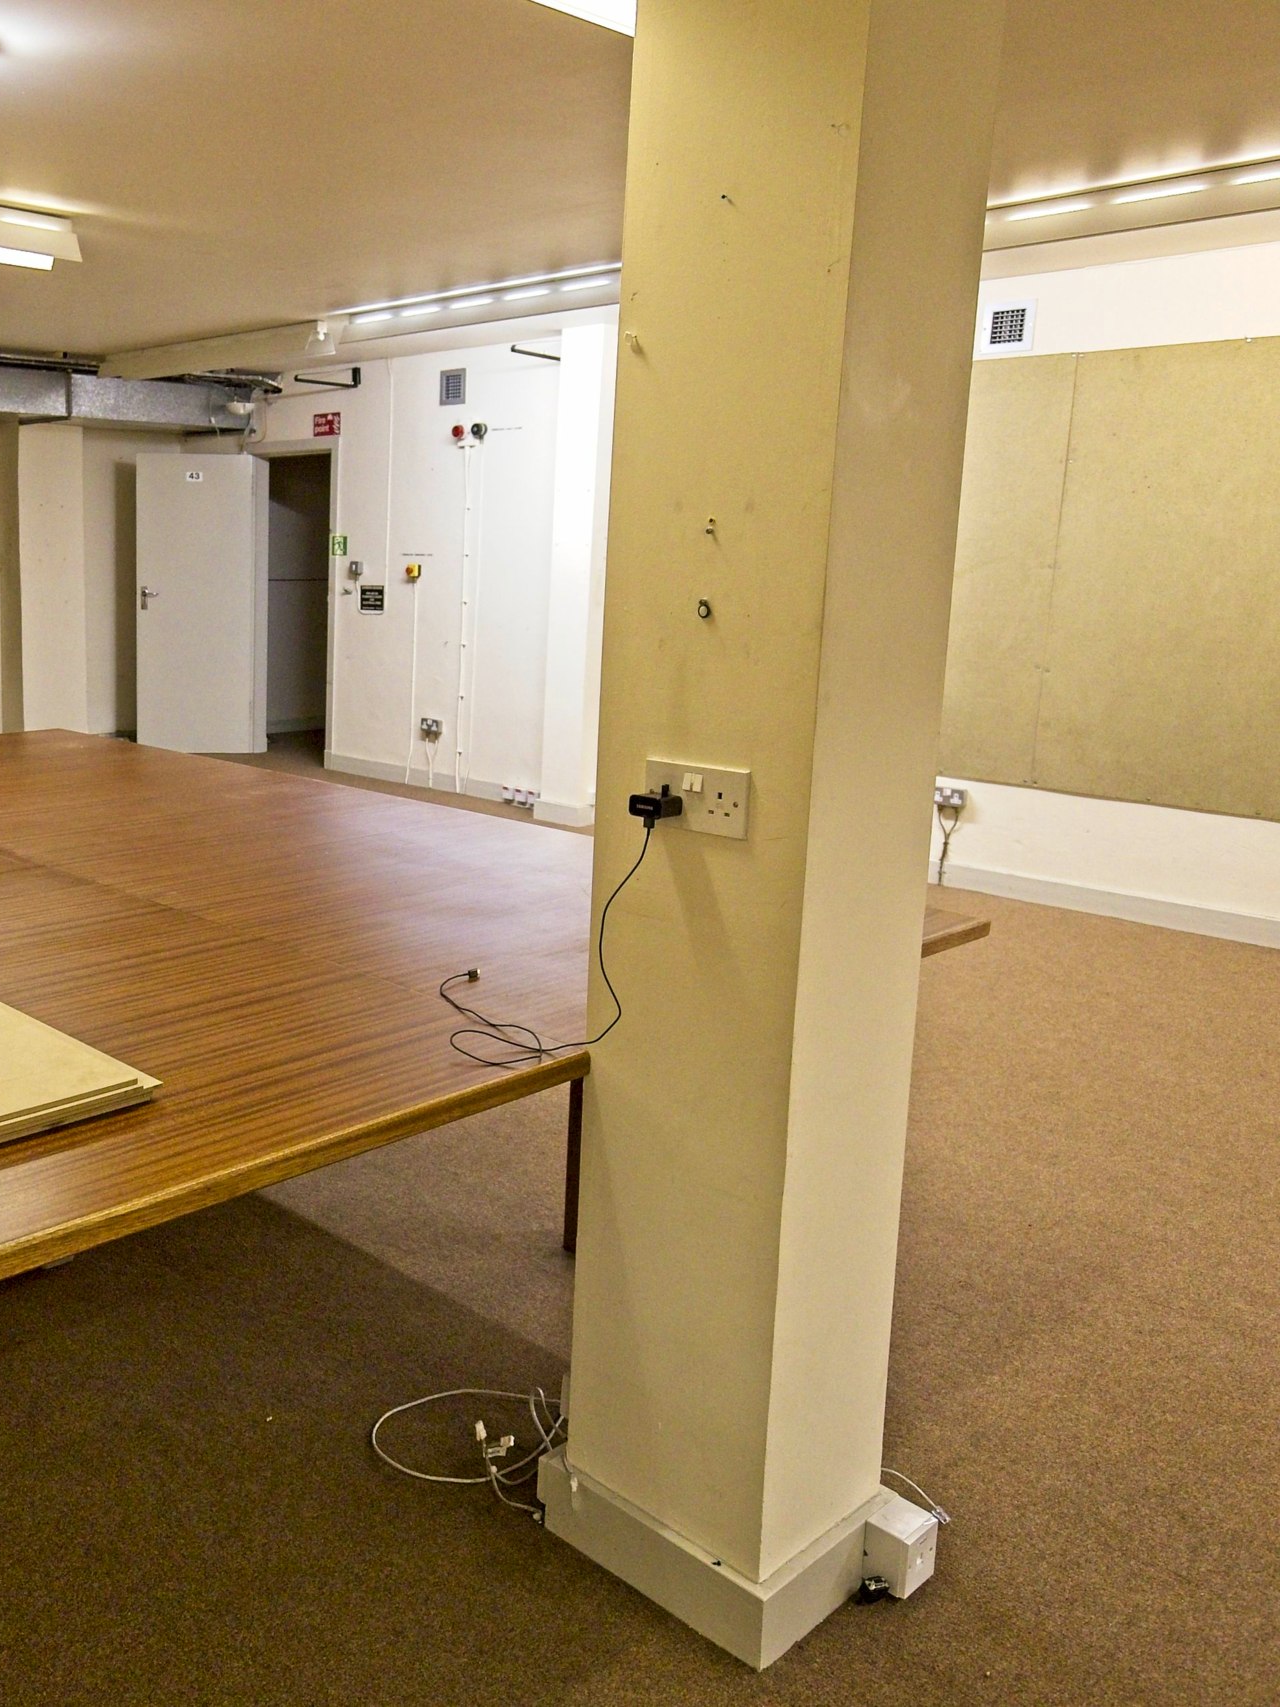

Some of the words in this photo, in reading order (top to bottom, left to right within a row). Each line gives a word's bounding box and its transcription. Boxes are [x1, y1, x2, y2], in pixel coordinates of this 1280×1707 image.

[314, 416, 326, 424] Fire
[314, 424, 330, 434] point
[188, 472, 200, 480] 43
